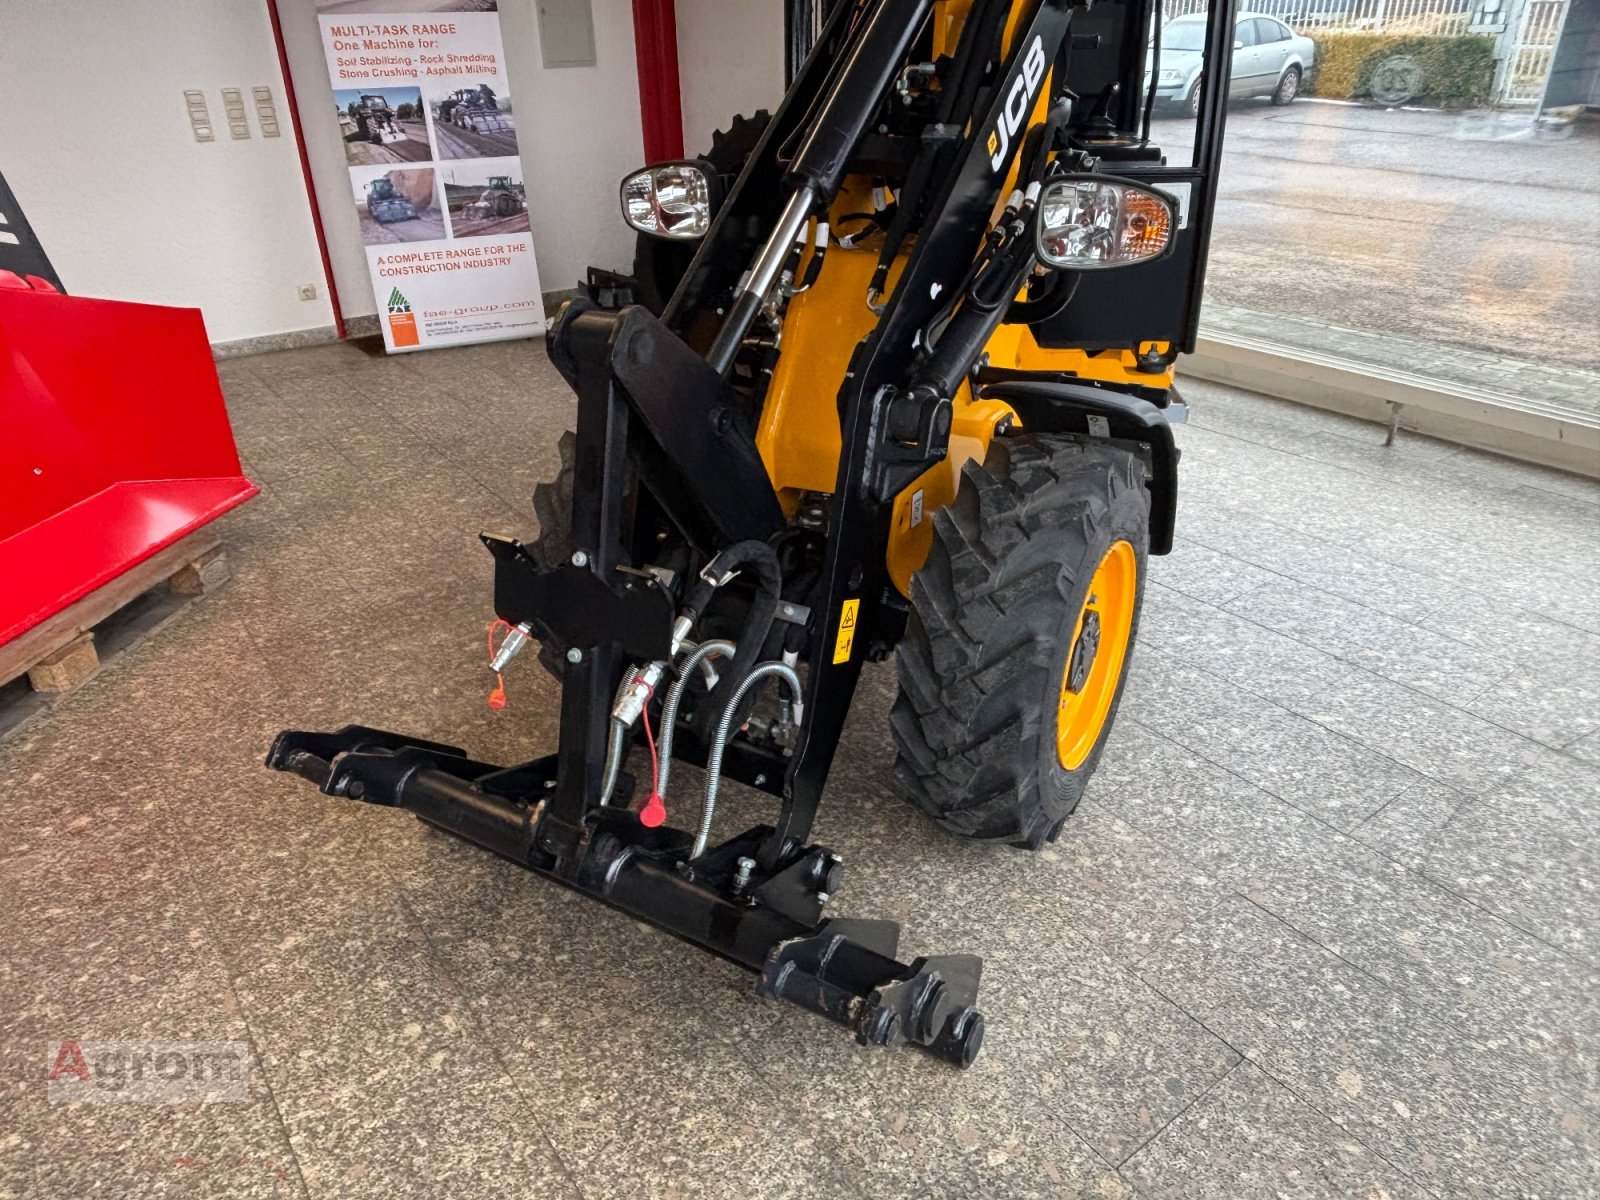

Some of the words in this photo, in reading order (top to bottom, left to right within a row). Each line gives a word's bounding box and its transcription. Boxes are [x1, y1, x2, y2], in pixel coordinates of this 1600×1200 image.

[331, 25, 408, 37] MULTI-TASK
[413, 24, 456, 35] RANGE
[334, 40, 359, 51] One
[363, 38, 414, 49] Machine
[418, 38, 438, 48] for:
[337, 57, 356, 67] Soil
[359, 55, 411, 66] Stabilizing
[420, 55, 444, 63] Rock
[447, 53, 496, 63] Shredding
[339, 69, 369, 79] Stone
[372, 68, 417, 78] Crushing
[426, 66, 463, 76] Asphalt
[466, 64, 497, 75] Milling
[992, 34, 1045, 172] JCB
[377, 257, 385, 265] A
[387, 251, 443, 264] COMPLETE
[446, 248, 481, 258] RANGE
[484, 246, 504, 255] FOR
[507, 243, 526, 253] THE
[380, 262, 461, 277] CONSTRUCTION
[463, 257, 512, 269] INDUSTRY
